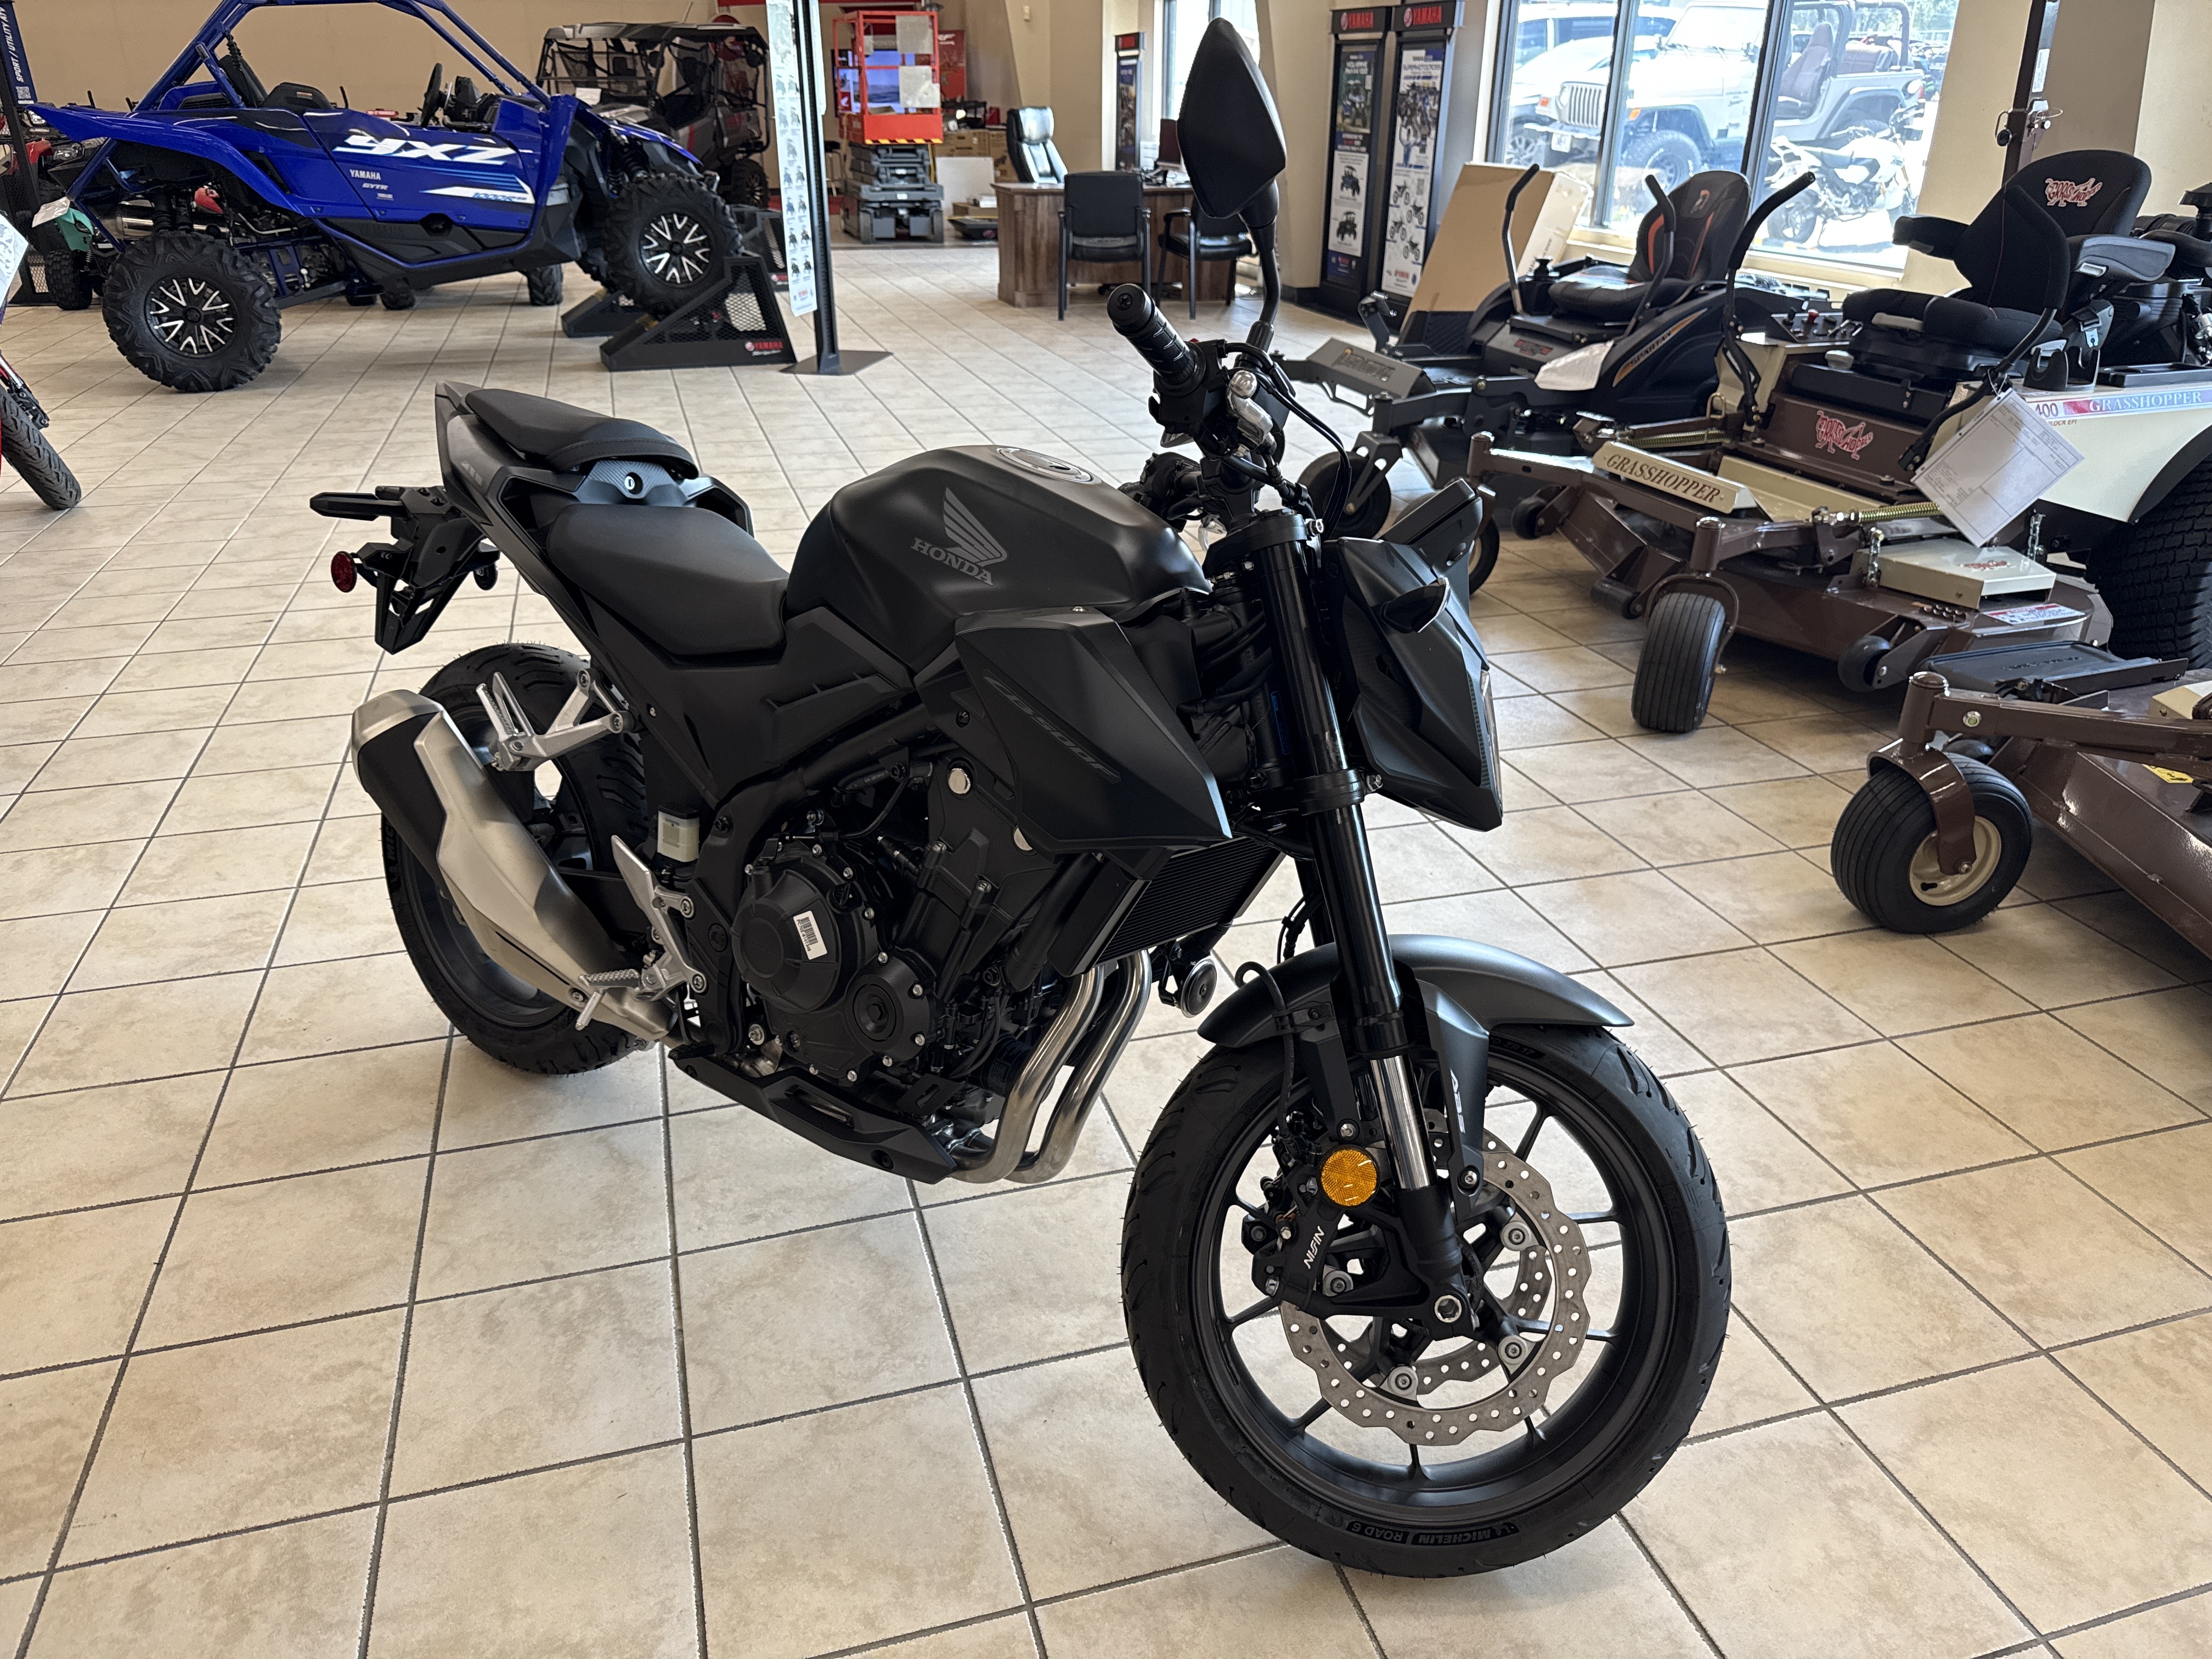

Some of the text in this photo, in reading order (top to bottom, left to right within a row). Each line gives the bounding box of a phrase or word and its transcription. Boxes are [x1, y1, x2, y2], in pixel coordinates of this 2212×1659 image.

[1348, 12, 1373, 29] YAMAHA
[1414, 5, 1442, 25] YAMAHA
[1, 21, 16, 52] UTILITY
[11, 57, 24, 82] SPORT
[332, 134, 517, 165] YXZ
[349, 168, 381, 180] YAMAHA
[1630, 330, 1672, 365] SPARTAN
[2089, 391, 2202, 412] GRASSHOPPER
[1606, 454, 1721, 503] GRASSHOPPER
[911, 538, 994, 586] HONDA
[1450, 1068, 1465, 1133] ABS
[1351, 1522, 1491, 1544] MICHELIN ROAD 6
